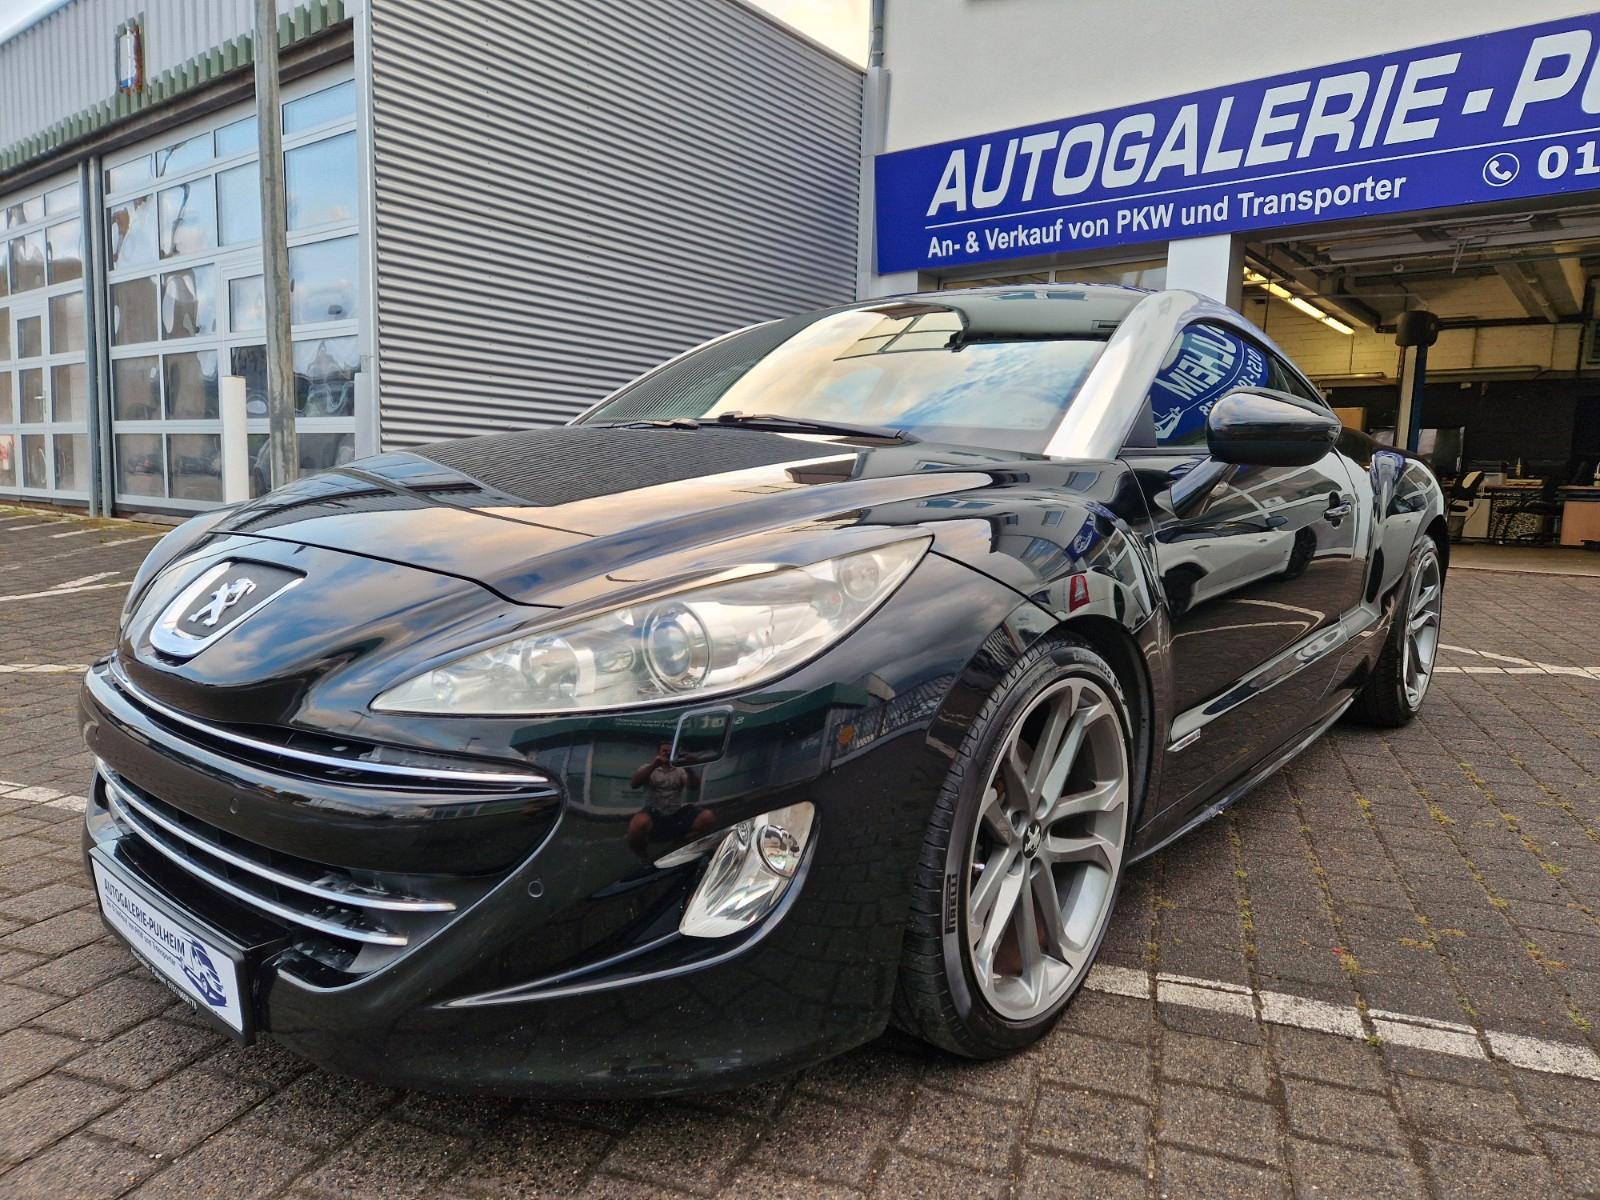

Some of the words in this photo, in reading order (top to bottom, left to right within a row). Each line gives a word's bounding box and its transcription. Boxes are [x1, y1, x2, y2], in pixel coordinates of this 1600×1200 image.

[927, 236, 961, 258] An-
[965, 231, 980, 253] &
[985, 218, 1064, 250] Verkauf
[1068, 217, 1109, 240] von
[1117, 203, 1174, 234] PKW
[1181, 195, 1229, 226] und
[1238, 175, 1407, 215] Transporter
[945, 873, 958, 935] PIRELLI
